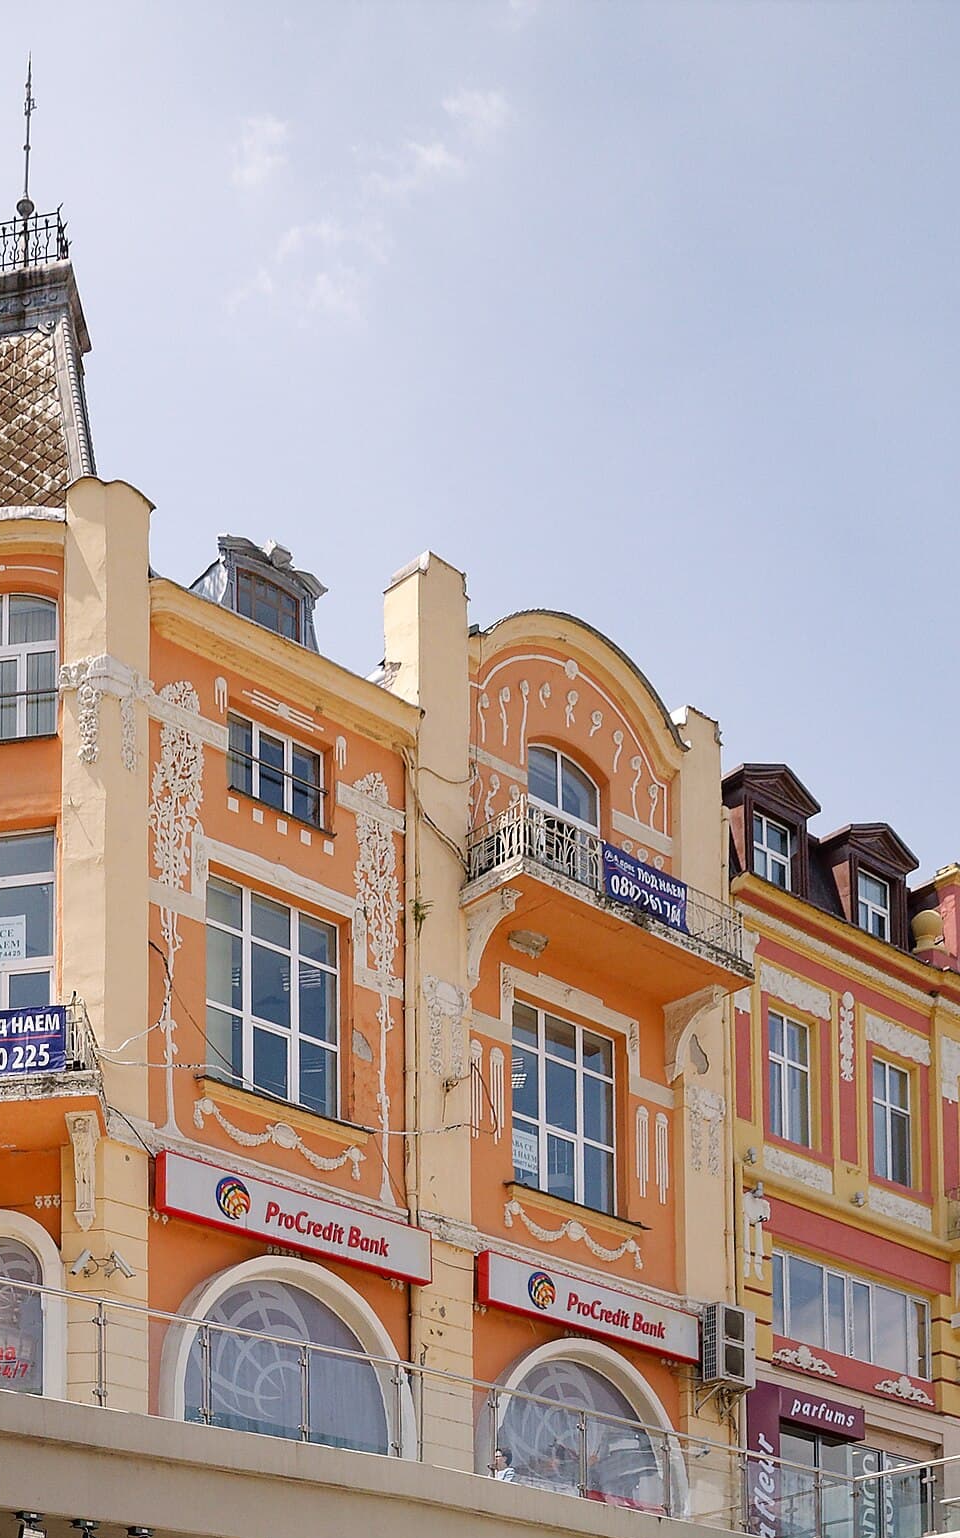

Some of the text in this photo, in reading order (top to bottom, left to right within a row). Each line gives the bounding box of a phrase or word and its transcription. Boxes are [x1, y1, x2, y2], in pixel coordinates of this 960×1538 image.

[637, 867, 685, 901] ПОД НАЕМ
[0, 929, 14, 938] СЕ
[11, 1013, 60, 1034] НАЕМ
[12, 1043, 50, 1069] 225
[265, 1201, 390, 1258] ProCredit Bank
[567, 1292, 666, 1340] ProCredit Bank
[791, 1398, 855, 1428] parfums
